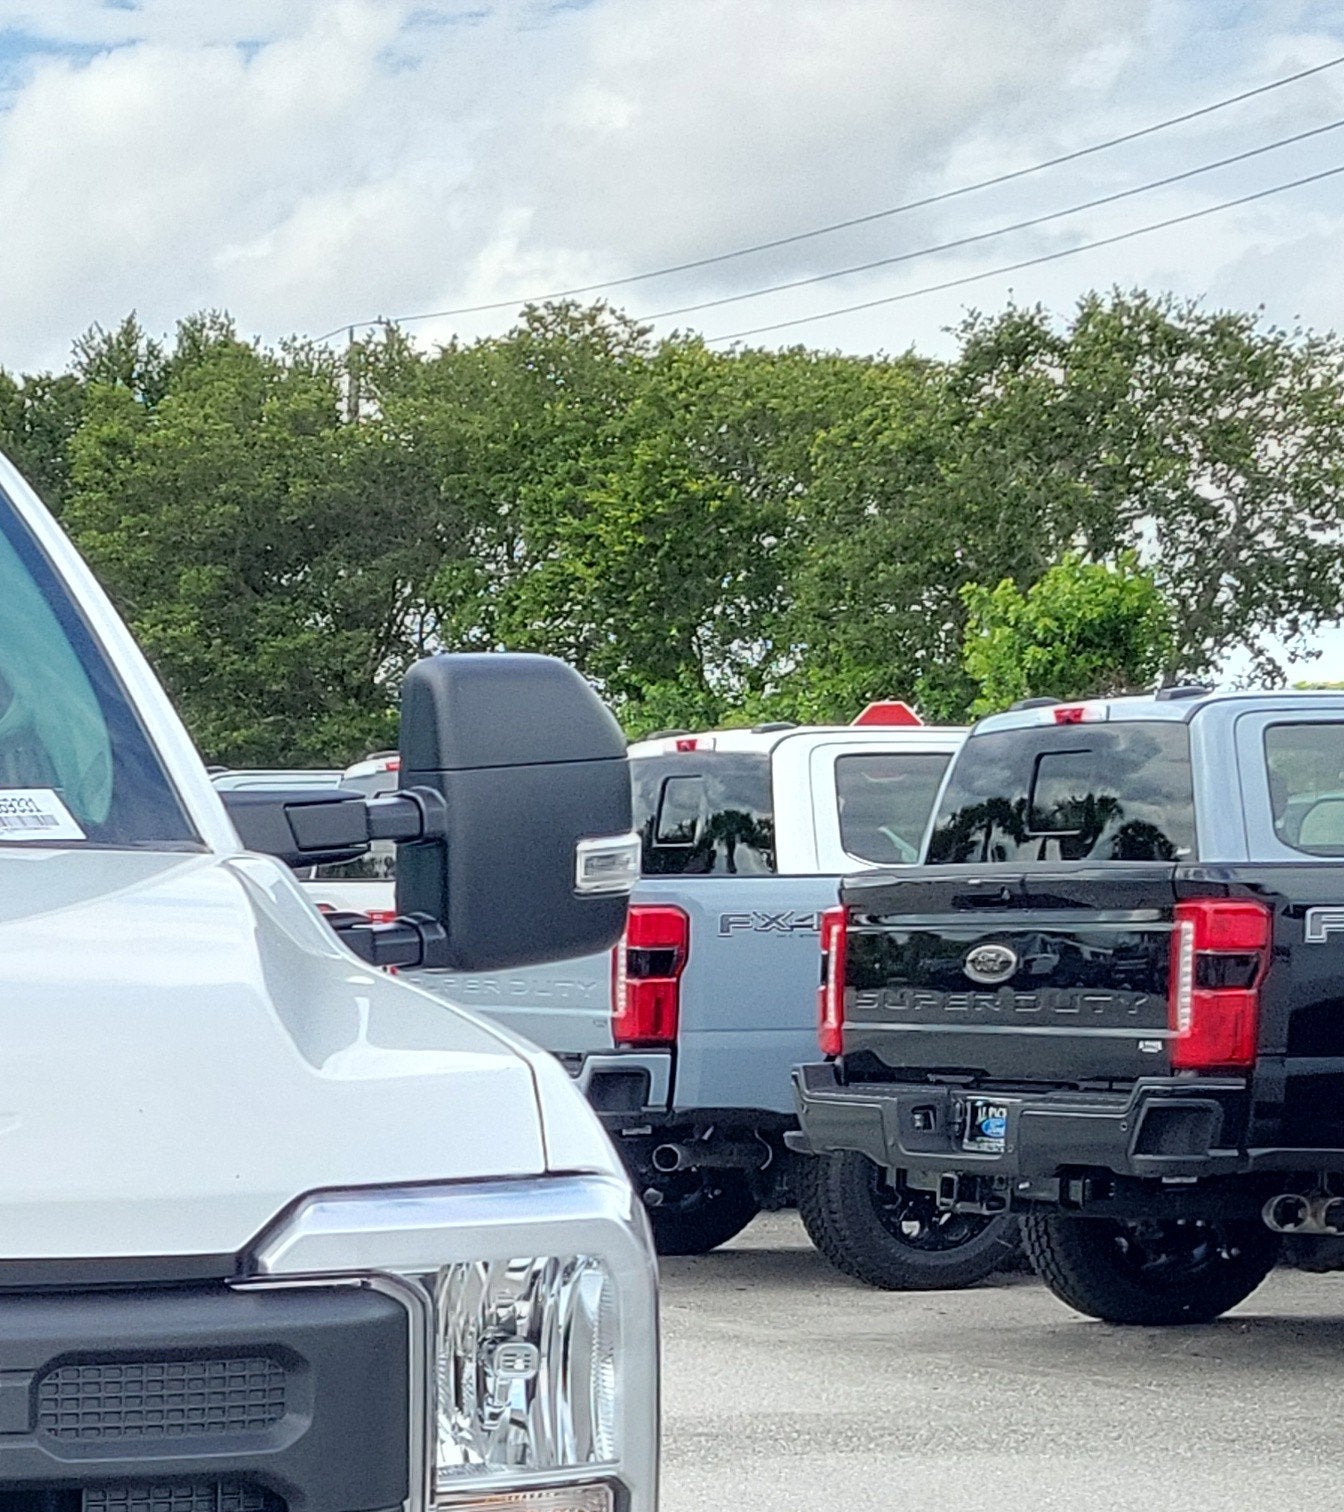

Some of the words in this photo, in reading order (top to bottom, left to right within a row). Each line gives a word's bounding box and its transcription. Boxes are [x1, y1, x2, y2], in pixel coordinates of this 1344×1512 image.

[717, 910, 821, 938] FX4
[856, 993, 1001, 1012] SUPER
[1013, 995, 1148, 1014] DUTY
